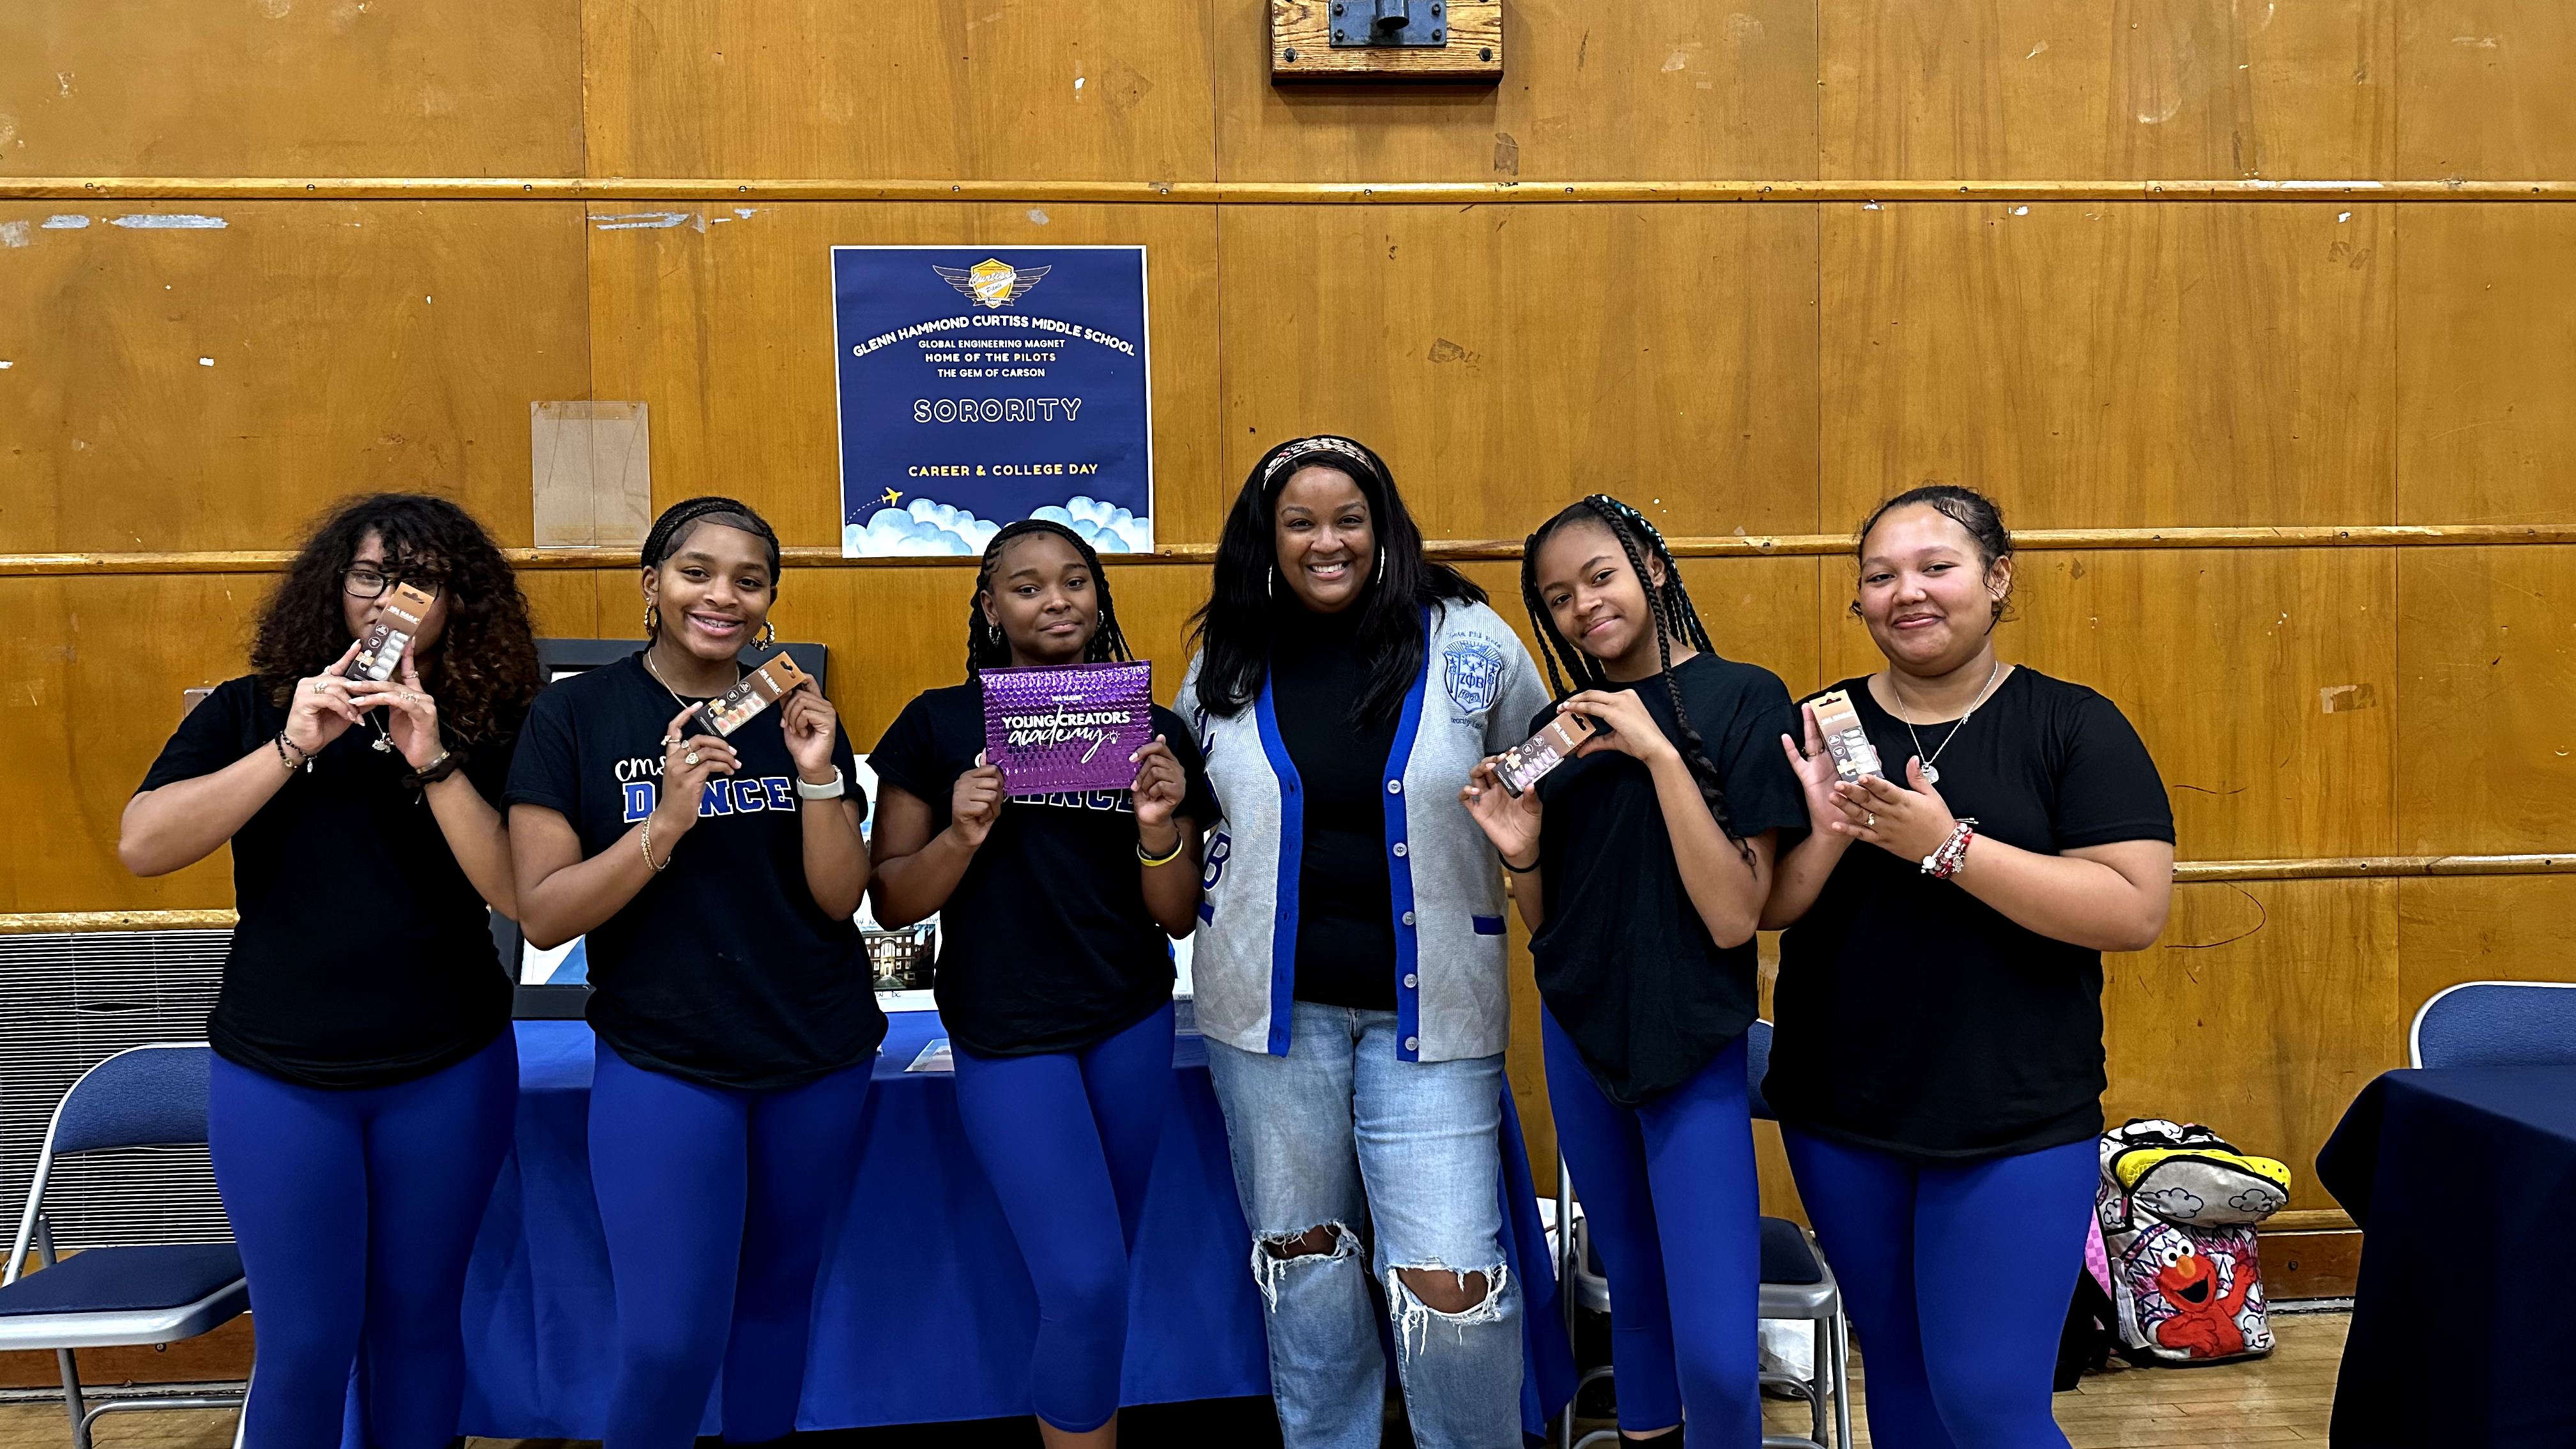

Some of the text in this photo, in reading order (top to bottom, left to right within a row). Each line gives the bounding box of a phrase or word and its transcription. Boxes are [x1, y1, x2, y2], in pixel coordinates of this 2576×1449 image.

[969, 271, 1014, 287] Curtiss
[853, 315, 1135, 357] GLENN HAMMOND CURTISS MIDDLE SCHOOL
[918, 339, 1066, 348] GLOBAL ENGINEERING MAGNET
[925, 353, 1056, 362] HOME OF THE PILOTS
[937, 368, 1045, 378] THE GEM OF CARSON
[914, 397, 1082, 423] SORORITY
[908, 463, 1098, 477] CAREER & COLLEGE DAY
[1001, 710, 1131, 730] YOUNG CREATORS
[1008, 705, 1110, 764] academy
[623, 776, 795, 823] DNCE
